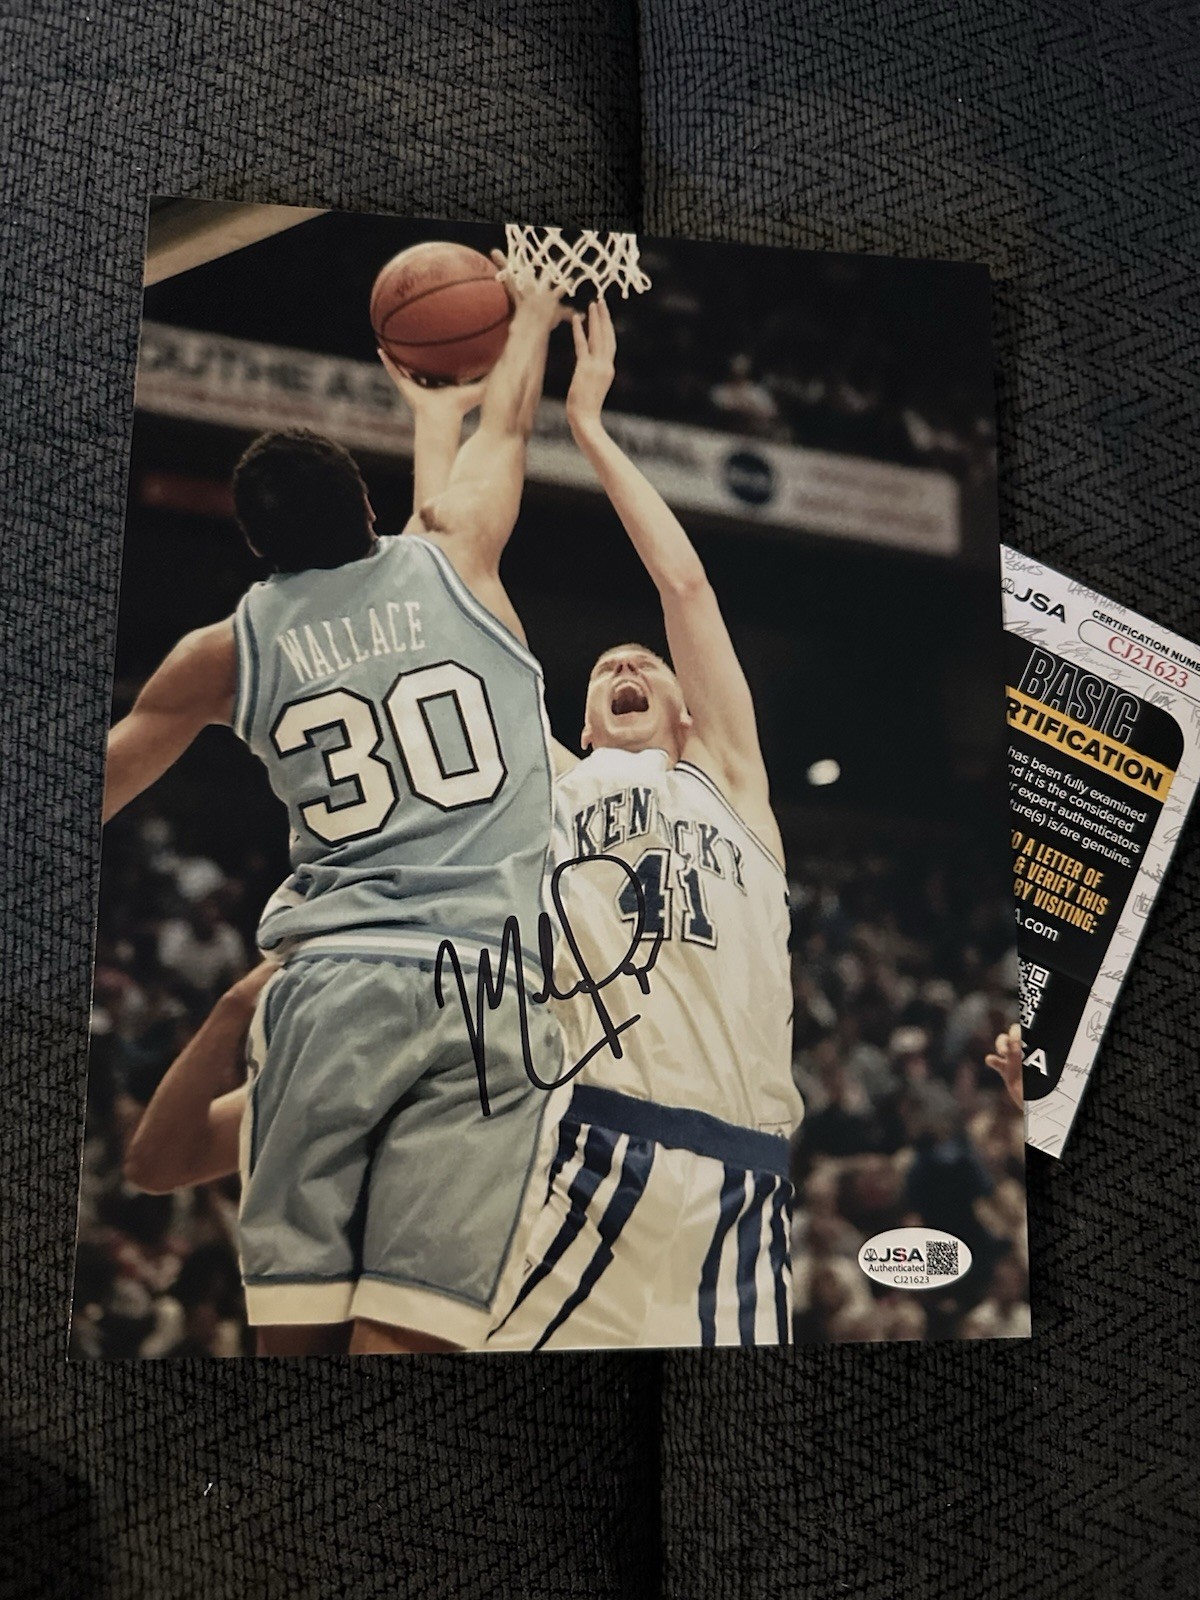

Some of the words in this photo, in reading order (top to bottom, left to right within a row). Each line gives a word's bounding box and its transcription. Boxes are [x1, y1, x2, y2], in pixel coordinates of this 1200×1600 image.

[1014, 588, 1066, 624] JSA
[1092, 609, 1169, 655] CERTIFICATION
[277, 601, 426, 684] WALLACE
[1108, 635, 1189, 688] CJ21623
[1018, 647, 1140, 745] BASIC
[269, 659, 509, 848] 30
[1007, 746, 1029, 764] has
[1031, 757, 1062, 781] been
[1063, 773, 1090, 795] fully
[1090, 789, 1147, 823] examined
[1024, 770, 1034, 783] it
[1034, 775, 1046, 789] is
[1047, 782, 1068, 799] the
[1069, 794, 1135, 832] considered
[572, 786, 747, 897] KENCKY
[1018, 786, 1057, 812] expert
[1057, 806, 1141, 853] authenticators
[1047, 817, 1081, 841] is/are
[1081, 836, 1132, 868] genuine.
[1012, 855, 1026, 875] &
[1027, 861, 1076, 898] VERIFY
[1076, 886, 1109, 916] THIS
[1022, 838, 1036, 857] A
[1035, 843, 1083, 878] LETTER
[1083, 867, 1105, 889] OF
[615, 848, 718, 950] 41
[1013, 877, 1034, 901] BY
[1033, 887, 1100, 934] VISITING:
[868, 1263, 925, 1273] Authenticated
[879, 1248, 925, 1262] JSA
[893, 1275, 930, 1285] CJ21623
